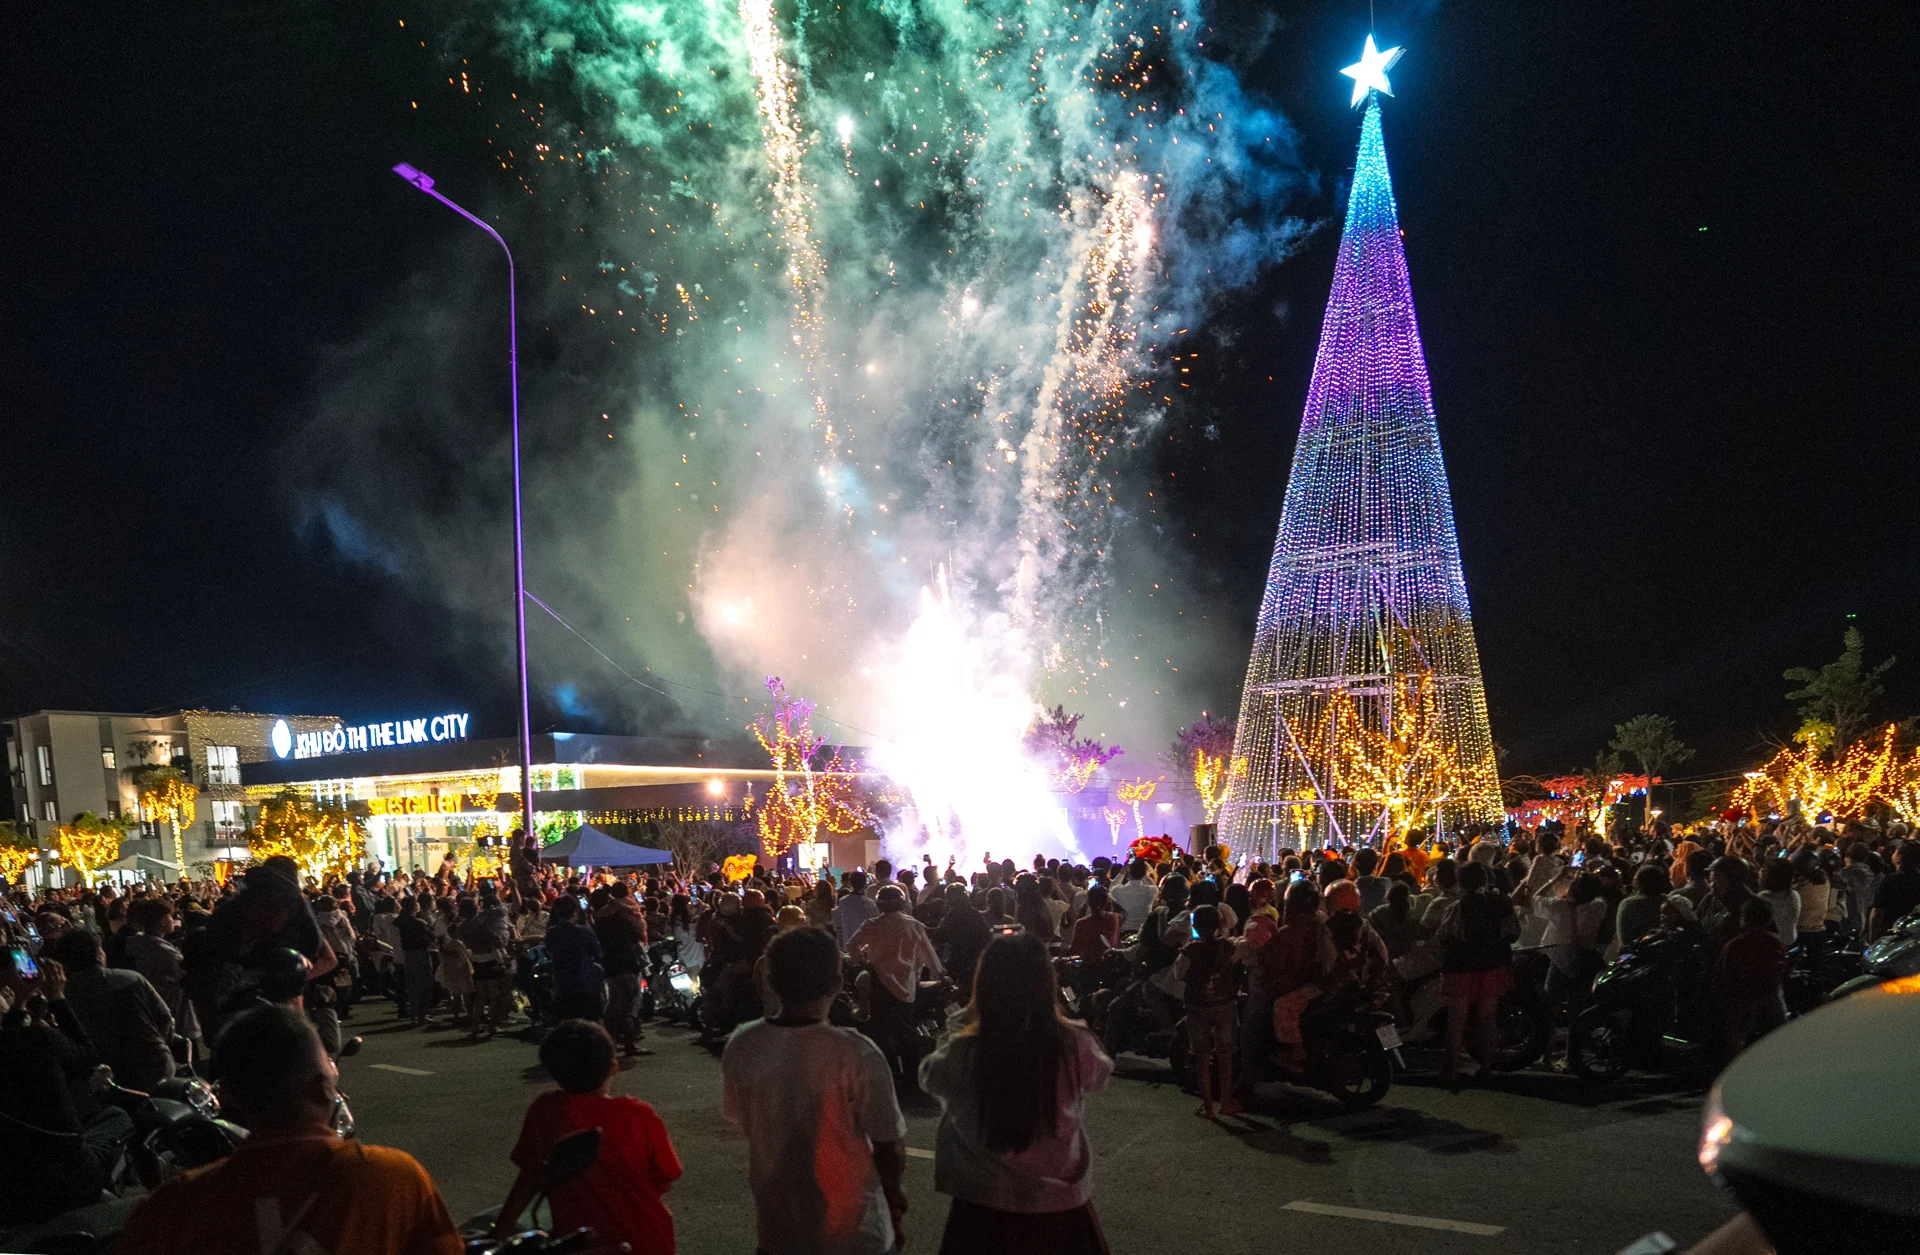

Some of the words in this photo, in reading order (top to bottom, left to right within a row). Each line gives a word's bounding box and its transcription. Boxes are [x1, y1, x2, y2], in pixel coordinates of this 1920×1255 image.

[297, 733, 322, 755] KHU
[368, 723, 395, 746] THE
[396, 719, 428, 744] LINK
[431, 713, 468, 741] CITY
[368, 796, 403, 816] SALES
[406, 793, 461, 815] GALLERY
